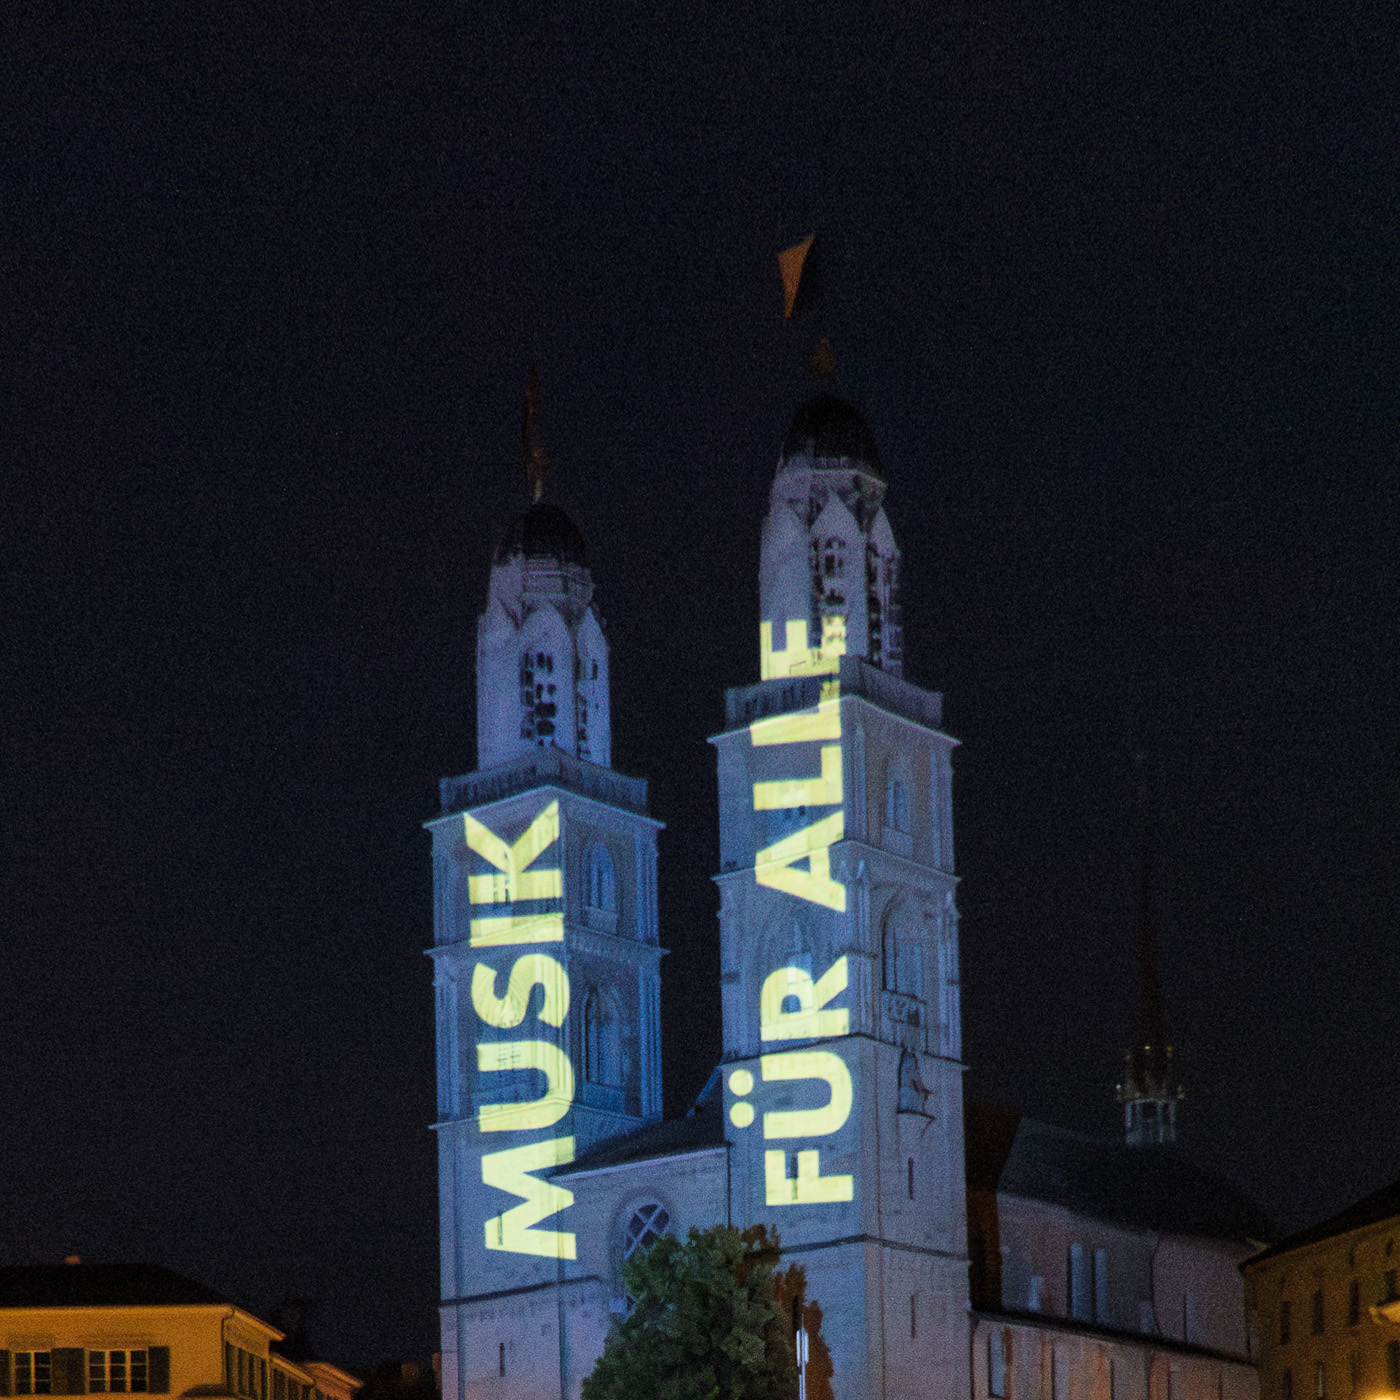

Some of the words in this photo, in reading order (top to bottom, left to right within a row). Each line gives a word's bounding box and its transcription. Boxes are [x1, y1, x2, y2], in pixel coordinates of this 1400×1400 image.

[750, 615, 846, 912] ALLE
[463, 800, 577, 1260] MUSIK
[729, 956, 854, 1206] FÜR
